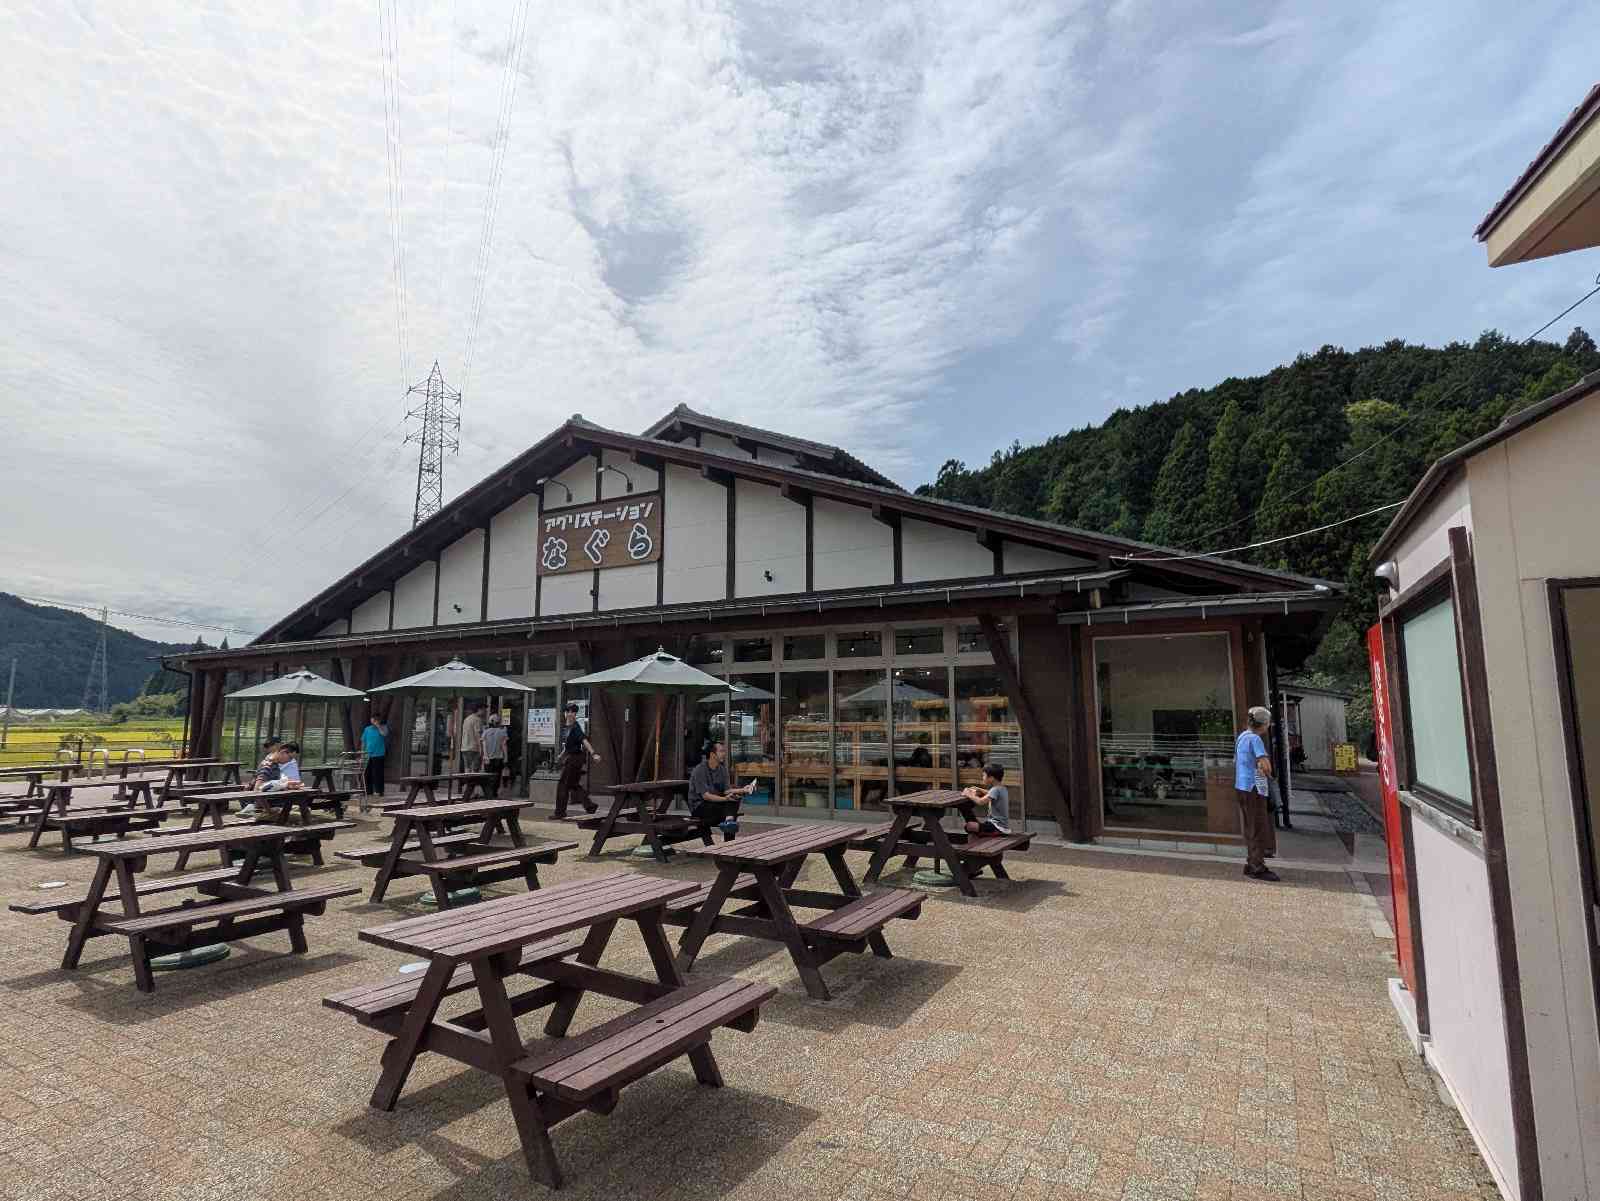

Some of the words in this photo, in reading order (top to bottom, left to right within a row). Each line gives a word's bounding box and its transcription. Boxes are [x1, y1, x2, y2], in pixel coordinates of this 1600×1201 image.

[545, 502, 654, 532] アグリステーション
[542, 522, 653, 570] なぐら
